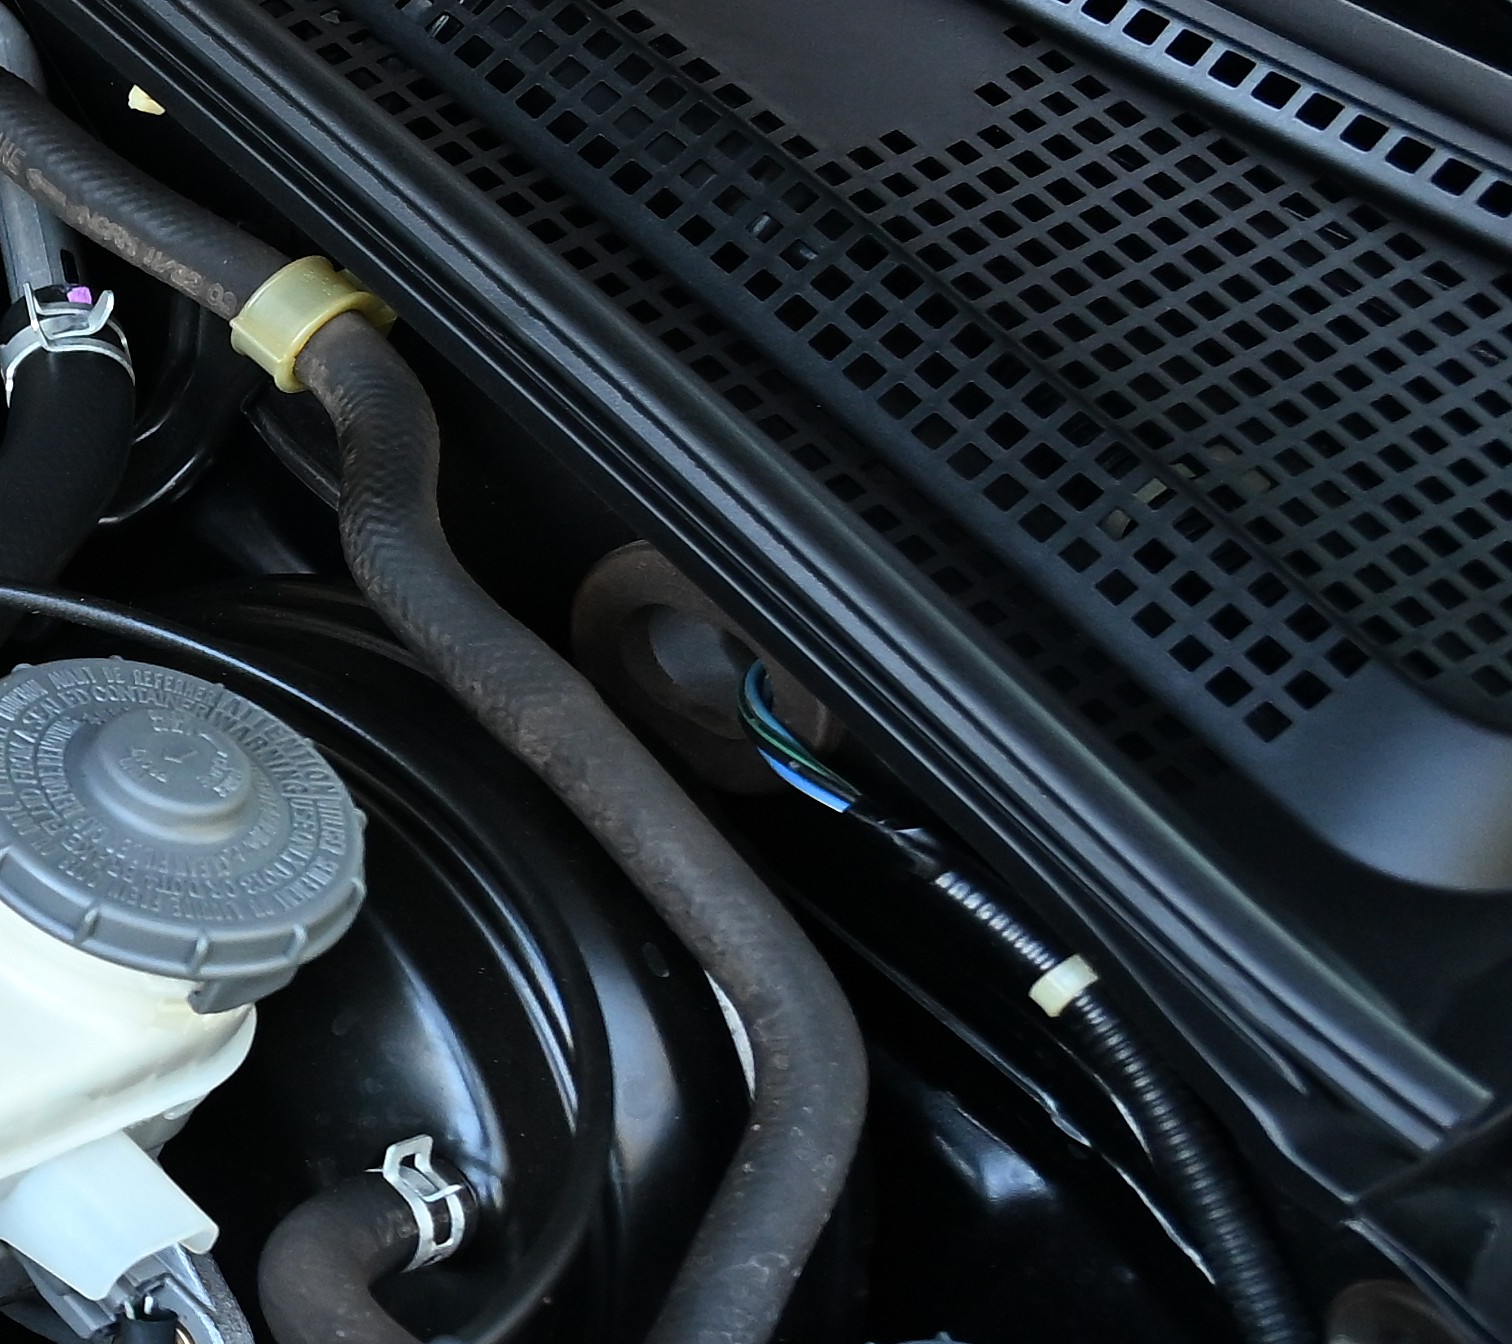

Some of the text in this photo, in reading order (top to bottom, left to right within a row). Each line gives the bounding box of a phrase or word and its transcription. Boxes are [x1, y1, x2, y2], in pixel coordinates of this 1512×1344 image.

[18, 686, 95, 735] SEALED
[84, 682, 212, 721] CONTAINER
[206, 705, 313, 791] WARNING
